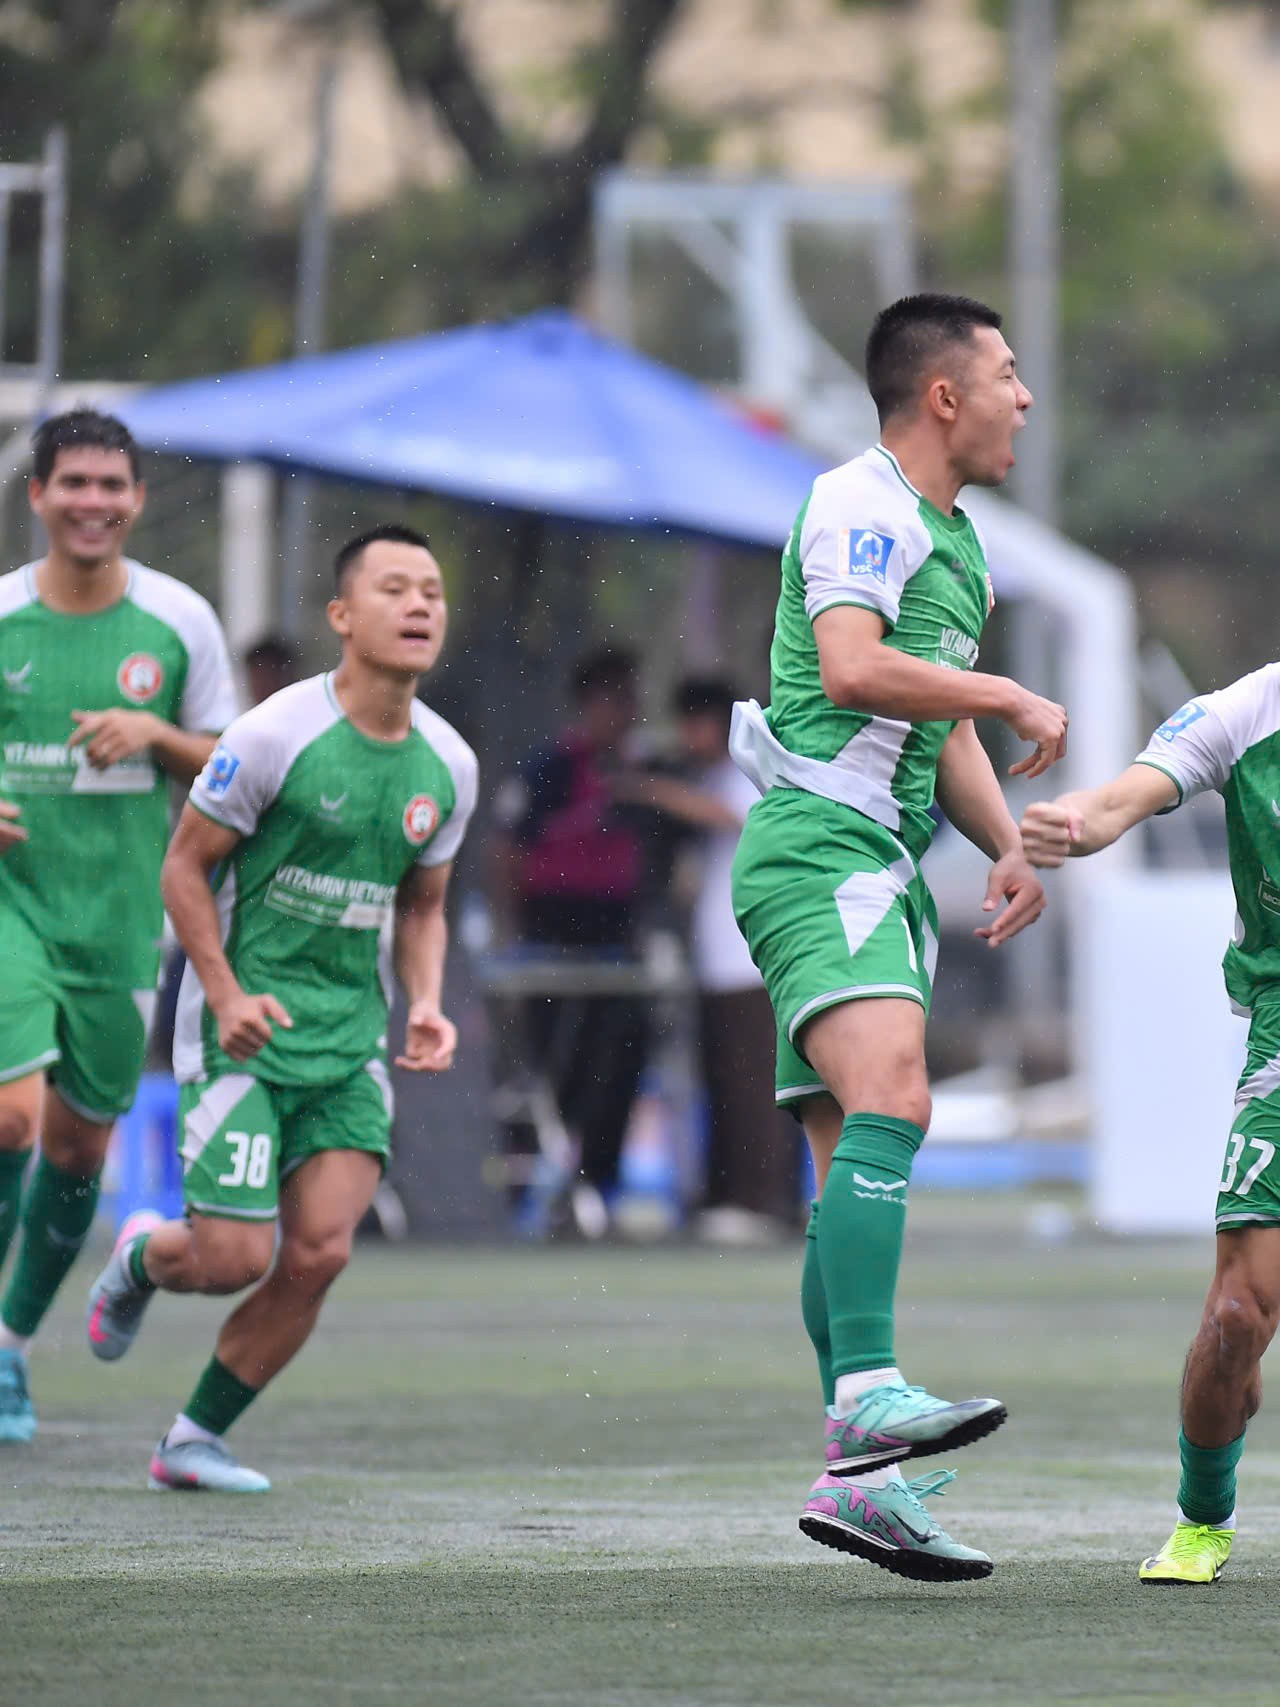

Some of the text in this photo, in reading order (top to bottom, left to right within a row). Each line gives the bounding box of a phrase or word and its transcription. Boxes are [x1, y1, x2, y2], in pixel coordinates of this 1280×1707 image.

[274, 865, 345, 898] VITAMIN
[218, 1131, 271, 1189] 38
[1219, 1132, 1276, 1195] 37
